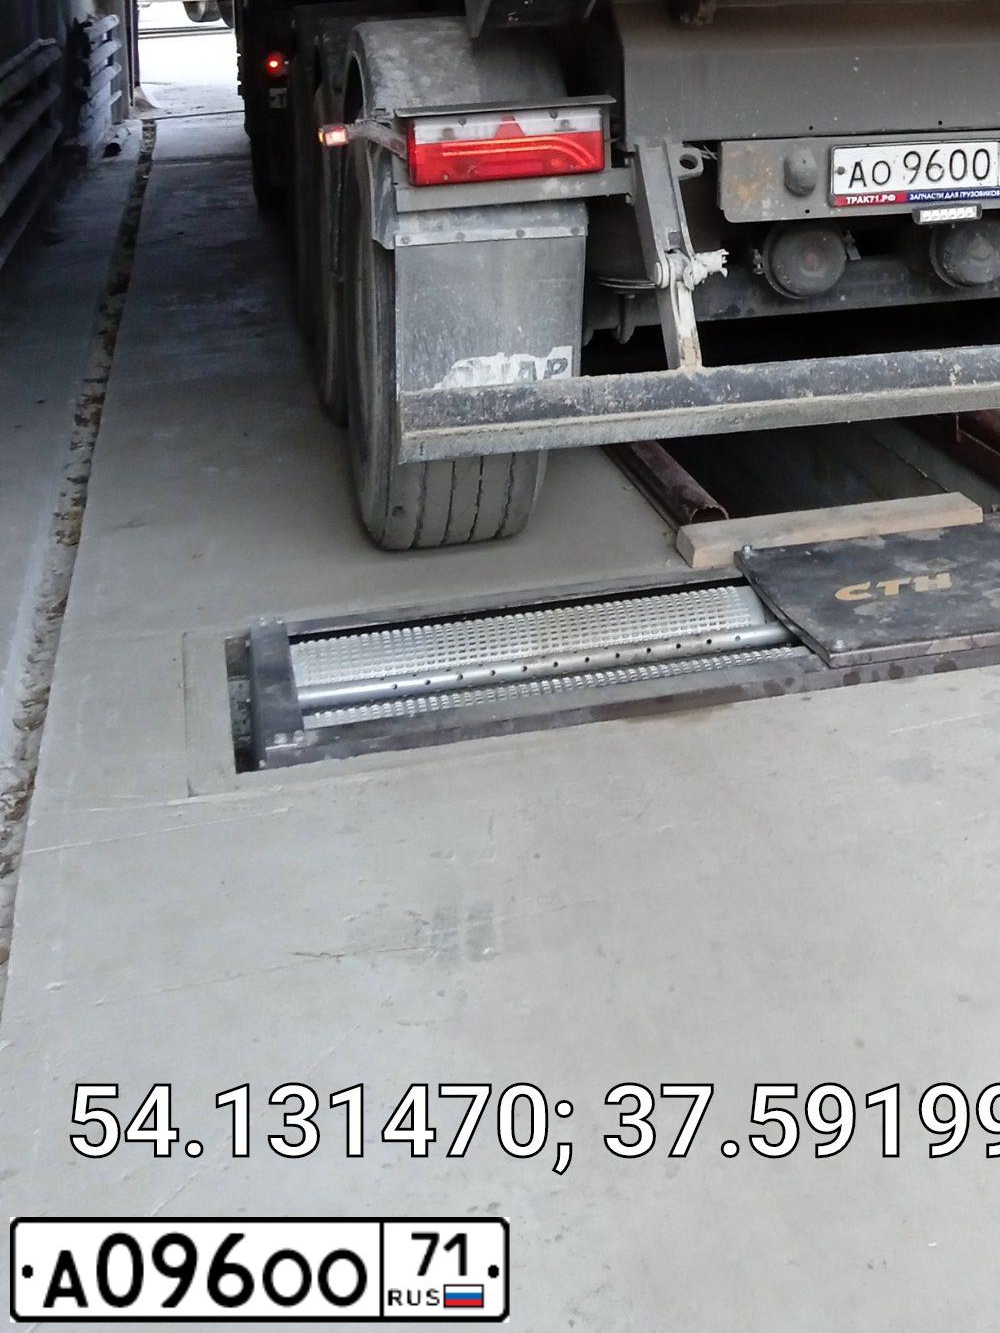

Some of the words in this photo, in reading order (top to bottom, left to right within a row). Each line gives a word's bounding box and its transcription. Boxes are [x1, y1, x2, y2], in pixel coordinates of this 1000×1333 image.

[903, 148, 991, 185] 9600
[845, 193, 897, 205] ТРАК71.РФ
[909, 191, 944, 201] ЗАПЧАСТИ
[945, 191, 959, 200] ДЛЯ
[960, 189, 1000, 199] ГРУЗОВИКОВ
